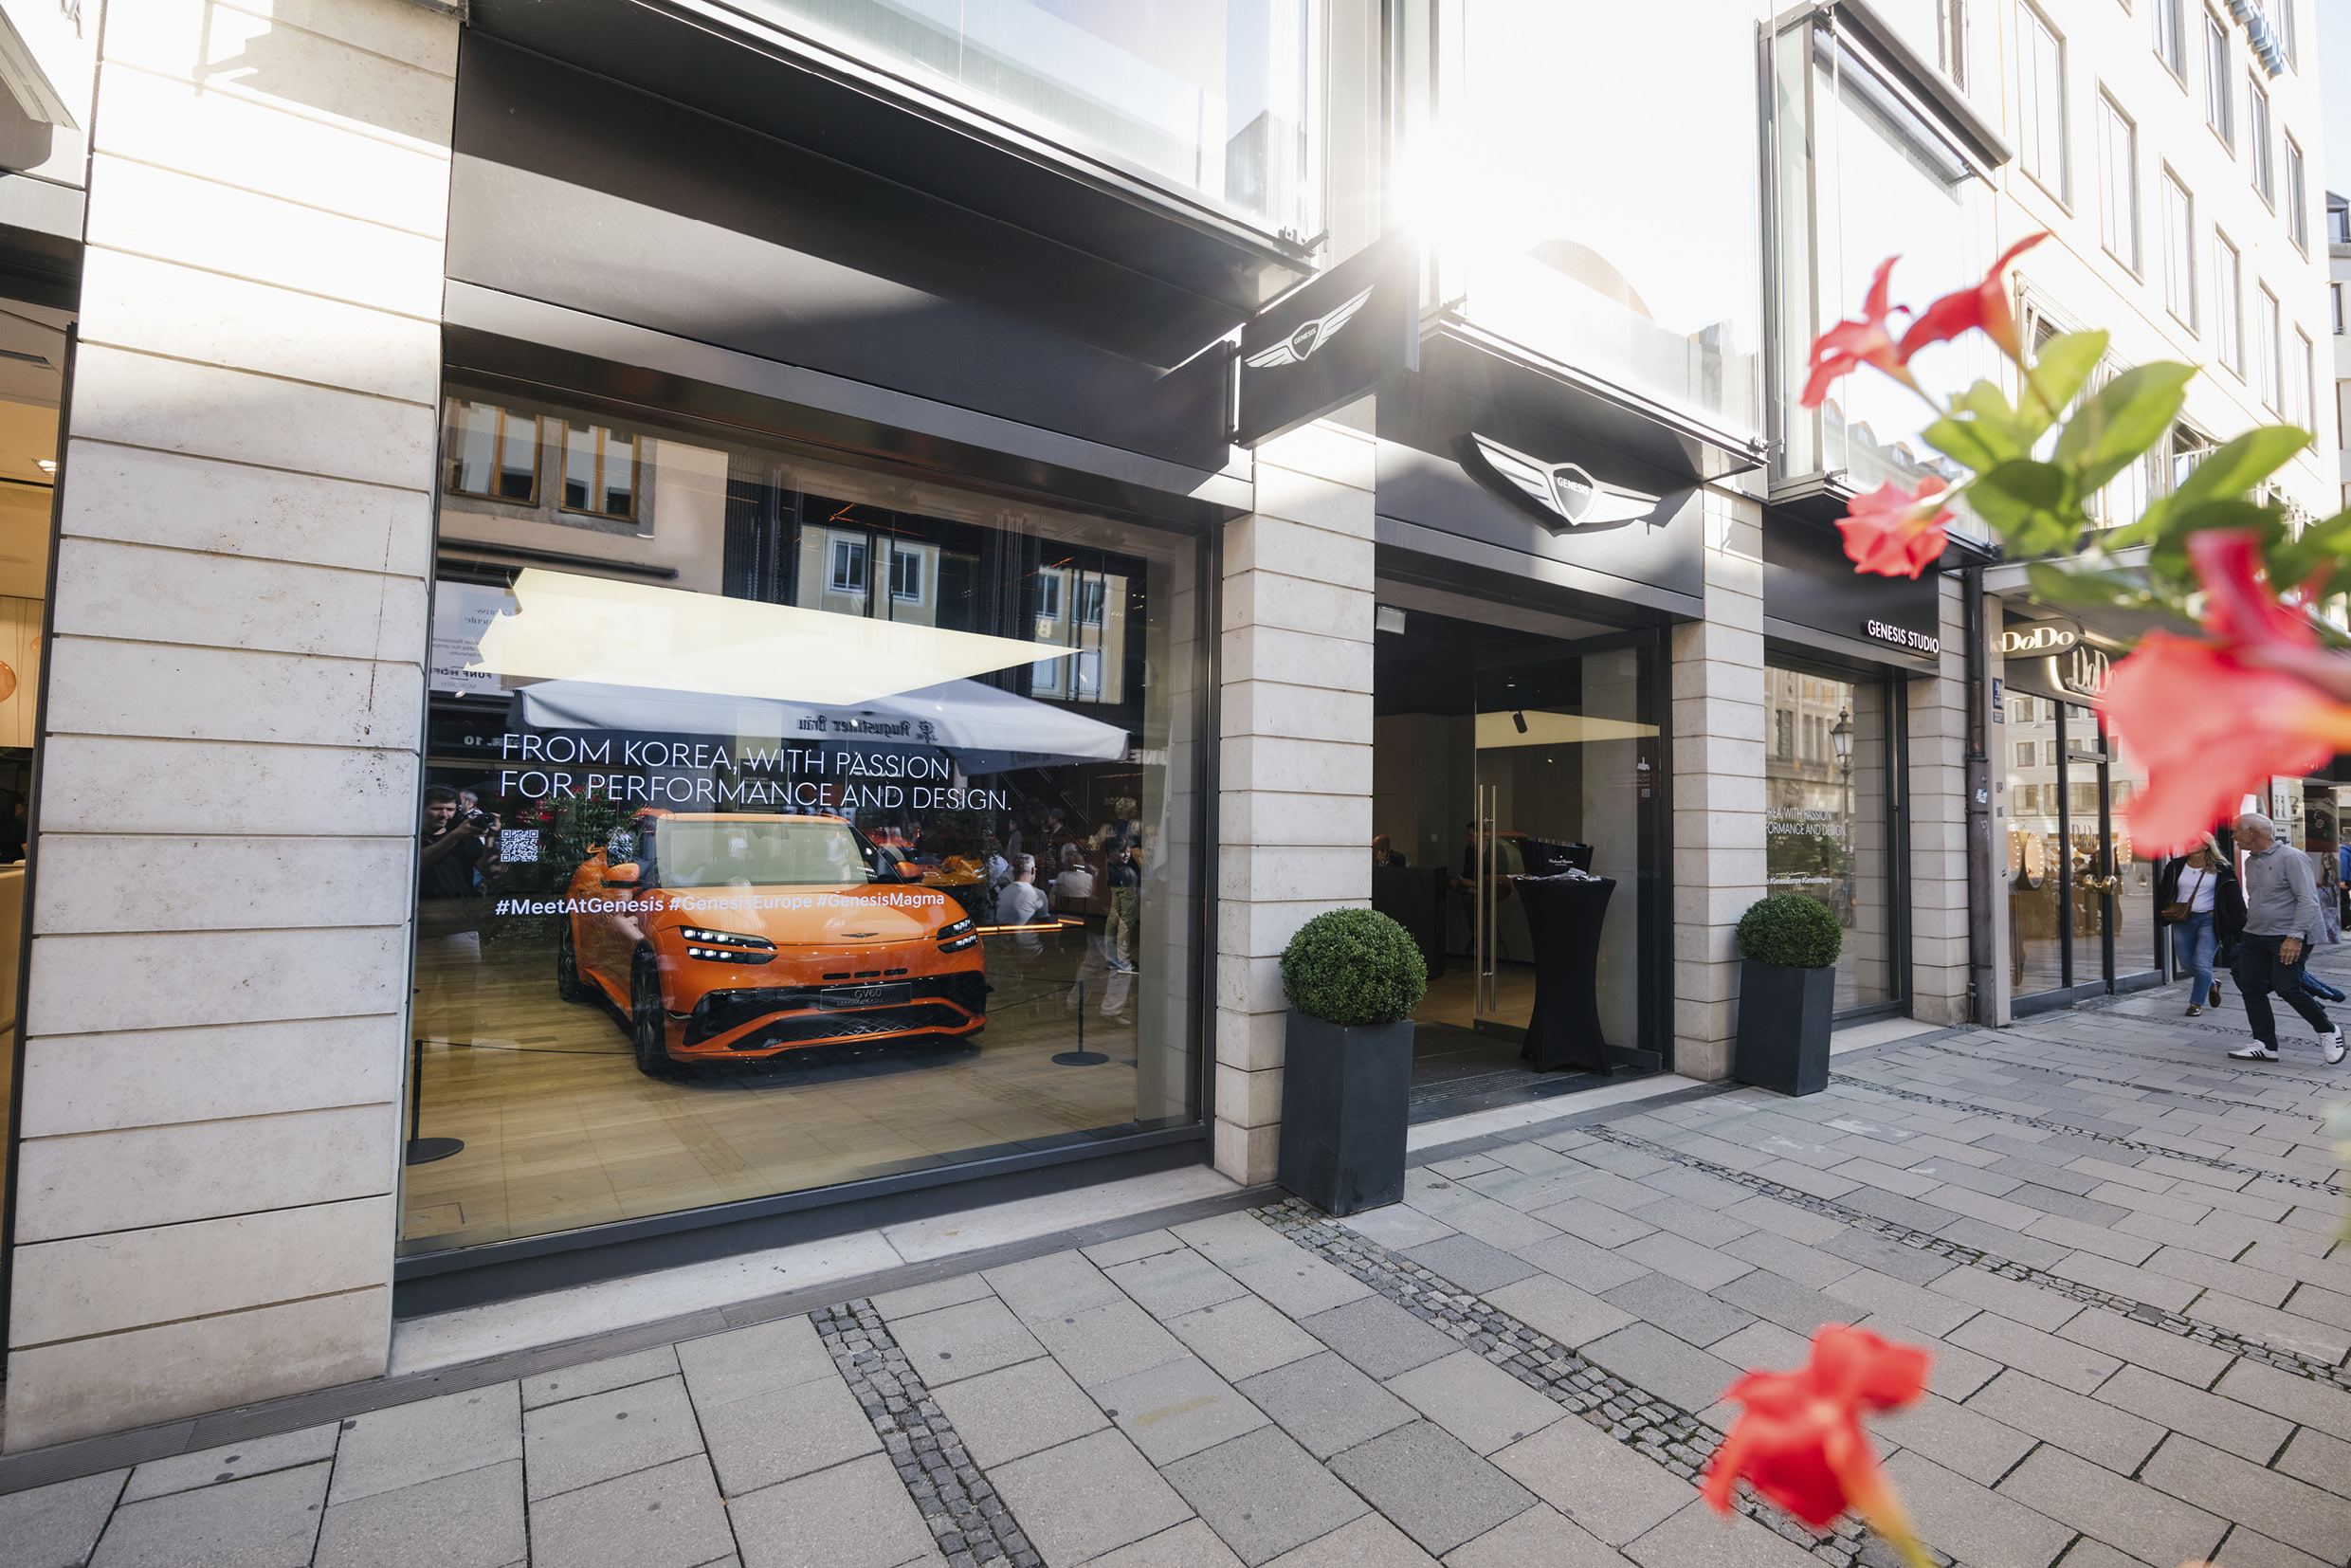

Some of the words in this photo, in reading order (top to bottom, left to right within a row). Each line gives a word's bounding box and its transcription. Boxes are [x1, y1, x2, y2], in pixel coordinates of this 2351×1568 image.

[1294, 328, 1317, 344] GENESIS
[1558, 477, 1589, 495] GENESIS
[1868, 619, 1907, 645] GENESIS
[1907, 630, 1940, 654] STUDIO
[2002, 627, 2075, 653] DoDo
[502, 733, 611, 765] FROM
[624, 739, 738, 775] KOREA,
[746, 747, 825, 775] WITH
[836, 752, 949, 780] PASSION
[501, 770, 575, 799] FOR
[587, 774, 832, 807] PERFORMANCE
[841, 784, 903, 809] AND
[913, 786, 1012, 811] DESIGN.
[1784, 807, 1803, 820] WITH
[1804, 809, 1832, 821] PASSION
[1805, 823, 1821, 836] AND
[1822, 824, 1848, 836] DESIGN.
[495, 896, 665, 916] #MeetAtGenesis
[668, 895, 812, 912] #GenesisEurope
[816, 892, 945, 908] #GenesisMagma
[854, 988, 882, 998] GV60
